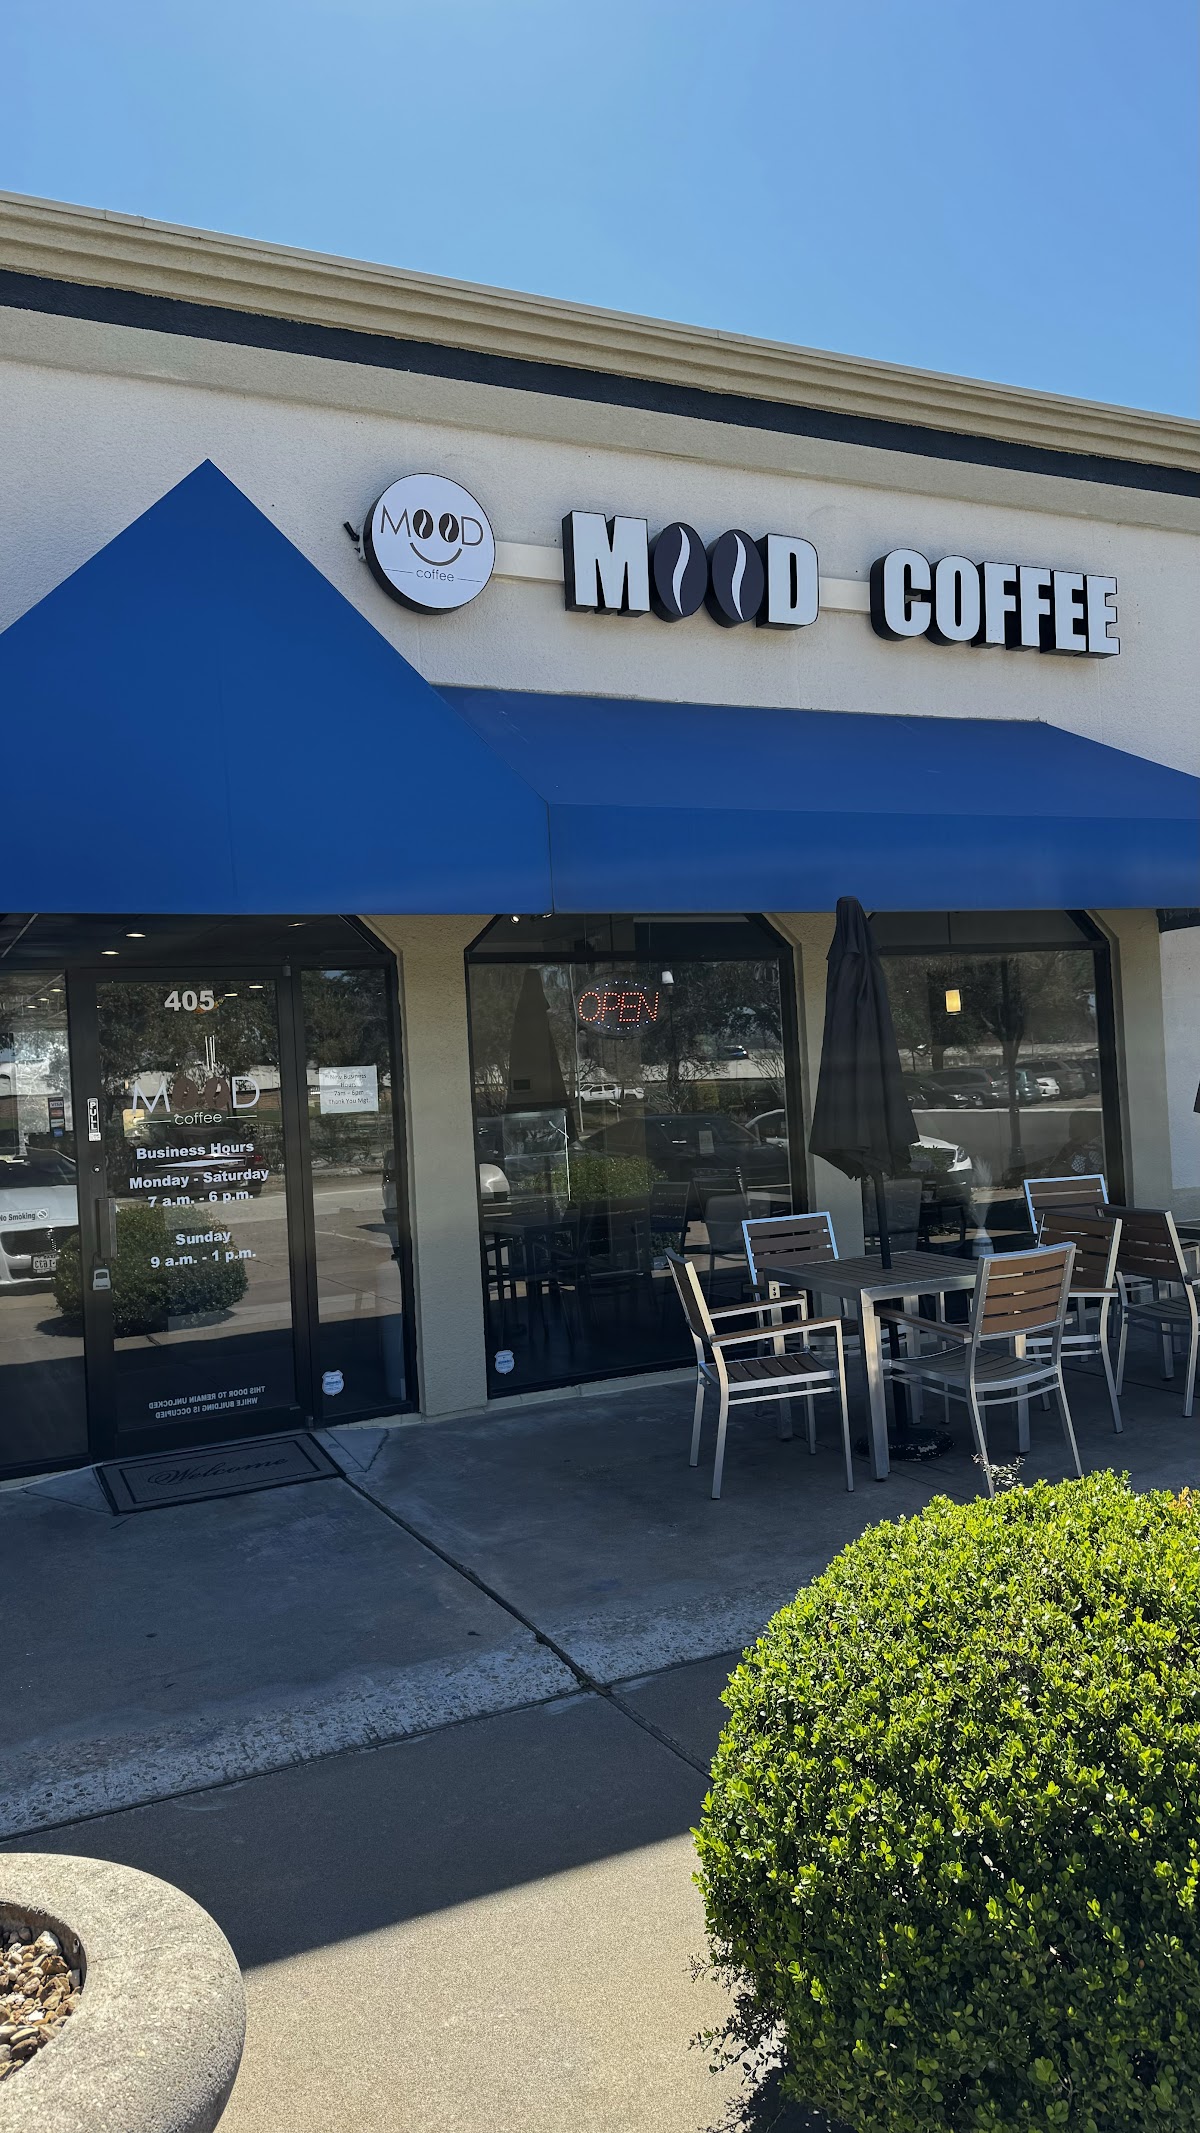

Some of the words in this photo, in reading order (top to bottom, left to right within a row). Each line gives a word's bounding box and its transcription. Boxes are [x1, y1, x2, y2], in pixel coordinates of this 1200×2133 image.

[380, 504, 484, 546] MOOD
[416, 569, 455, 582] coffee
[564, 510, 819, 628] MOOD
[871, 548, 1121, 658] COFFEE
[164, 990, 215, 1011] 405
[578, 991, 660, 1021] OPEN
[132, 1076, 260, 1113] MOOD
[90, 1101, 98, 1130] PULL
[174, 1112, 222, 1125] coffee
[136, 1146, 206, 1160] Business
[210, 1143, 255, 1155] Hours
[129, 1175, 190, 1190] Monday
[203, 1169, 269, 1184] Saturday
[147, 1196, 157, 1208] 7
[162, 1195, 195, 1207] a.m.
[208, 1191, 218, 1203] 6
[222, 1191, 254, 1204] p.m.
[8, 1212, 36, 1221] Smoking
[175, 1231, 232, 1246] Sunday
[150, 1256, 161, 1268] 9
[165, 1255, 198, 1267] a.m.
[211, 1250, 220, 1261] 1
[225, 1249, 257, 1263] p.m.
[148, 1459, 288, 1486] Welcome
